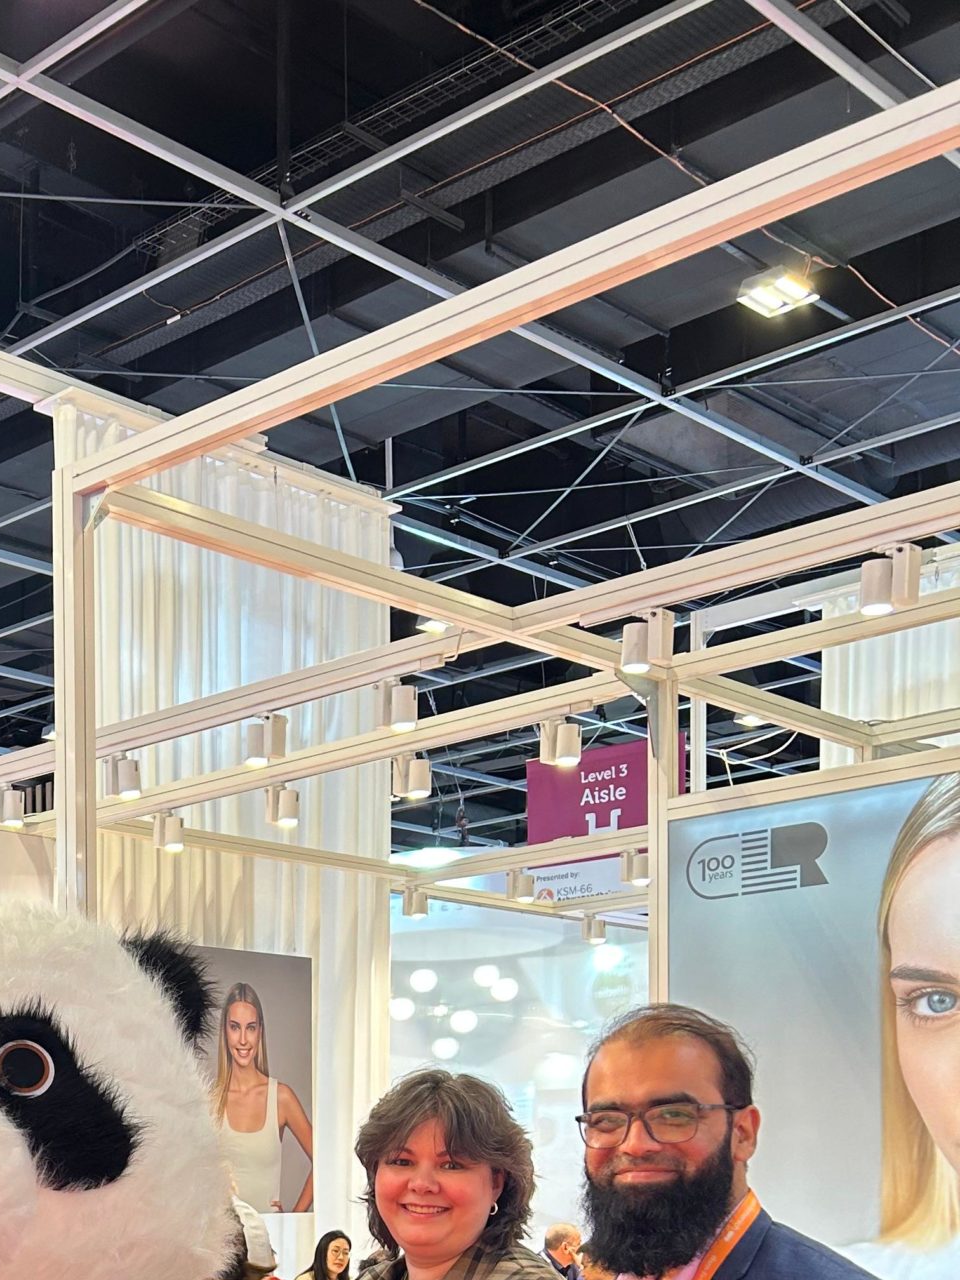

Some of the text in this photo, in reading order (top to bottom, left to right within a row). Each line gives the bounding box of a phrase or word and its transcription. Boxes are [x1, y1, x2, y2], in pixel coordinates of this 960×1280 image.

[580, 762, 629, 784] Level 3
[580, 783, 627, 807] Aisle
[697, 854, 736, 882] 100
[708, 869, 734, 883] years
[536, 873, 569, 882] Presented
[556, 884, 593, 897] KSM-66
